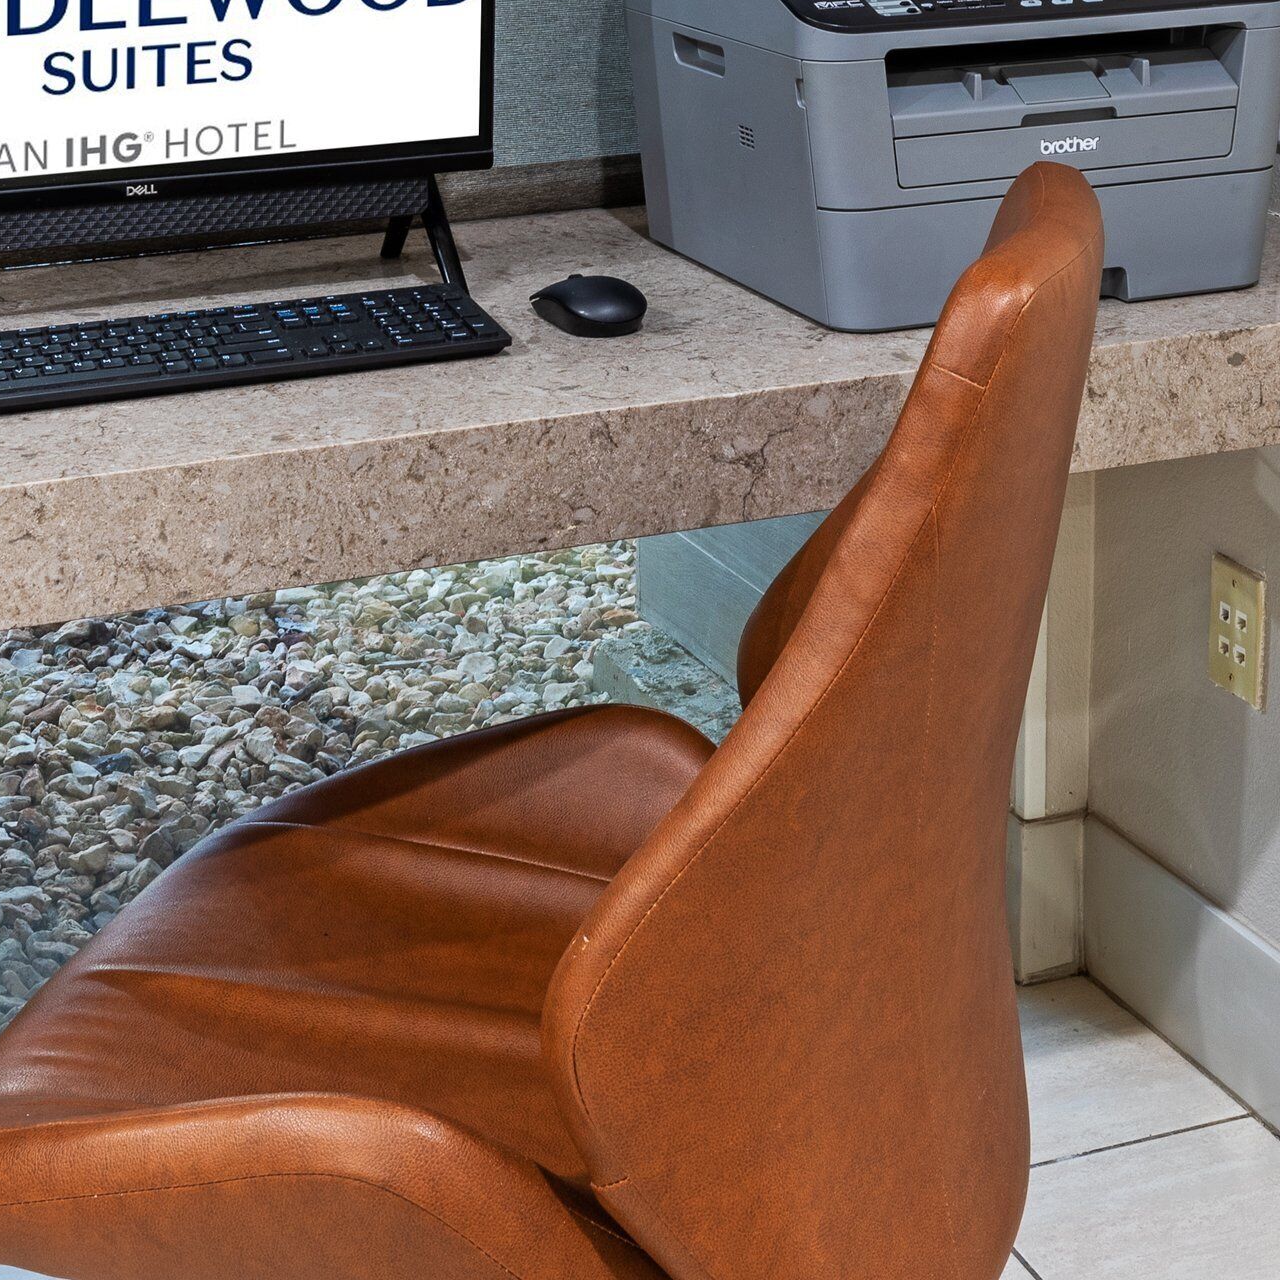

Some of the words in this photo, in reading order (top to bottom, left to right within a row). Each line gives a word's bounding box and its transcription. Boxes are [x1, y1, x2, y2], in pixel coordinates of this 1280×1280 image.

[42, 38, 253, 96] SUITES
[165, 119, 297, 158] HOTEL
[1040, 136, 1100, 155] brother
[126, 184, 158, 196] DELL
